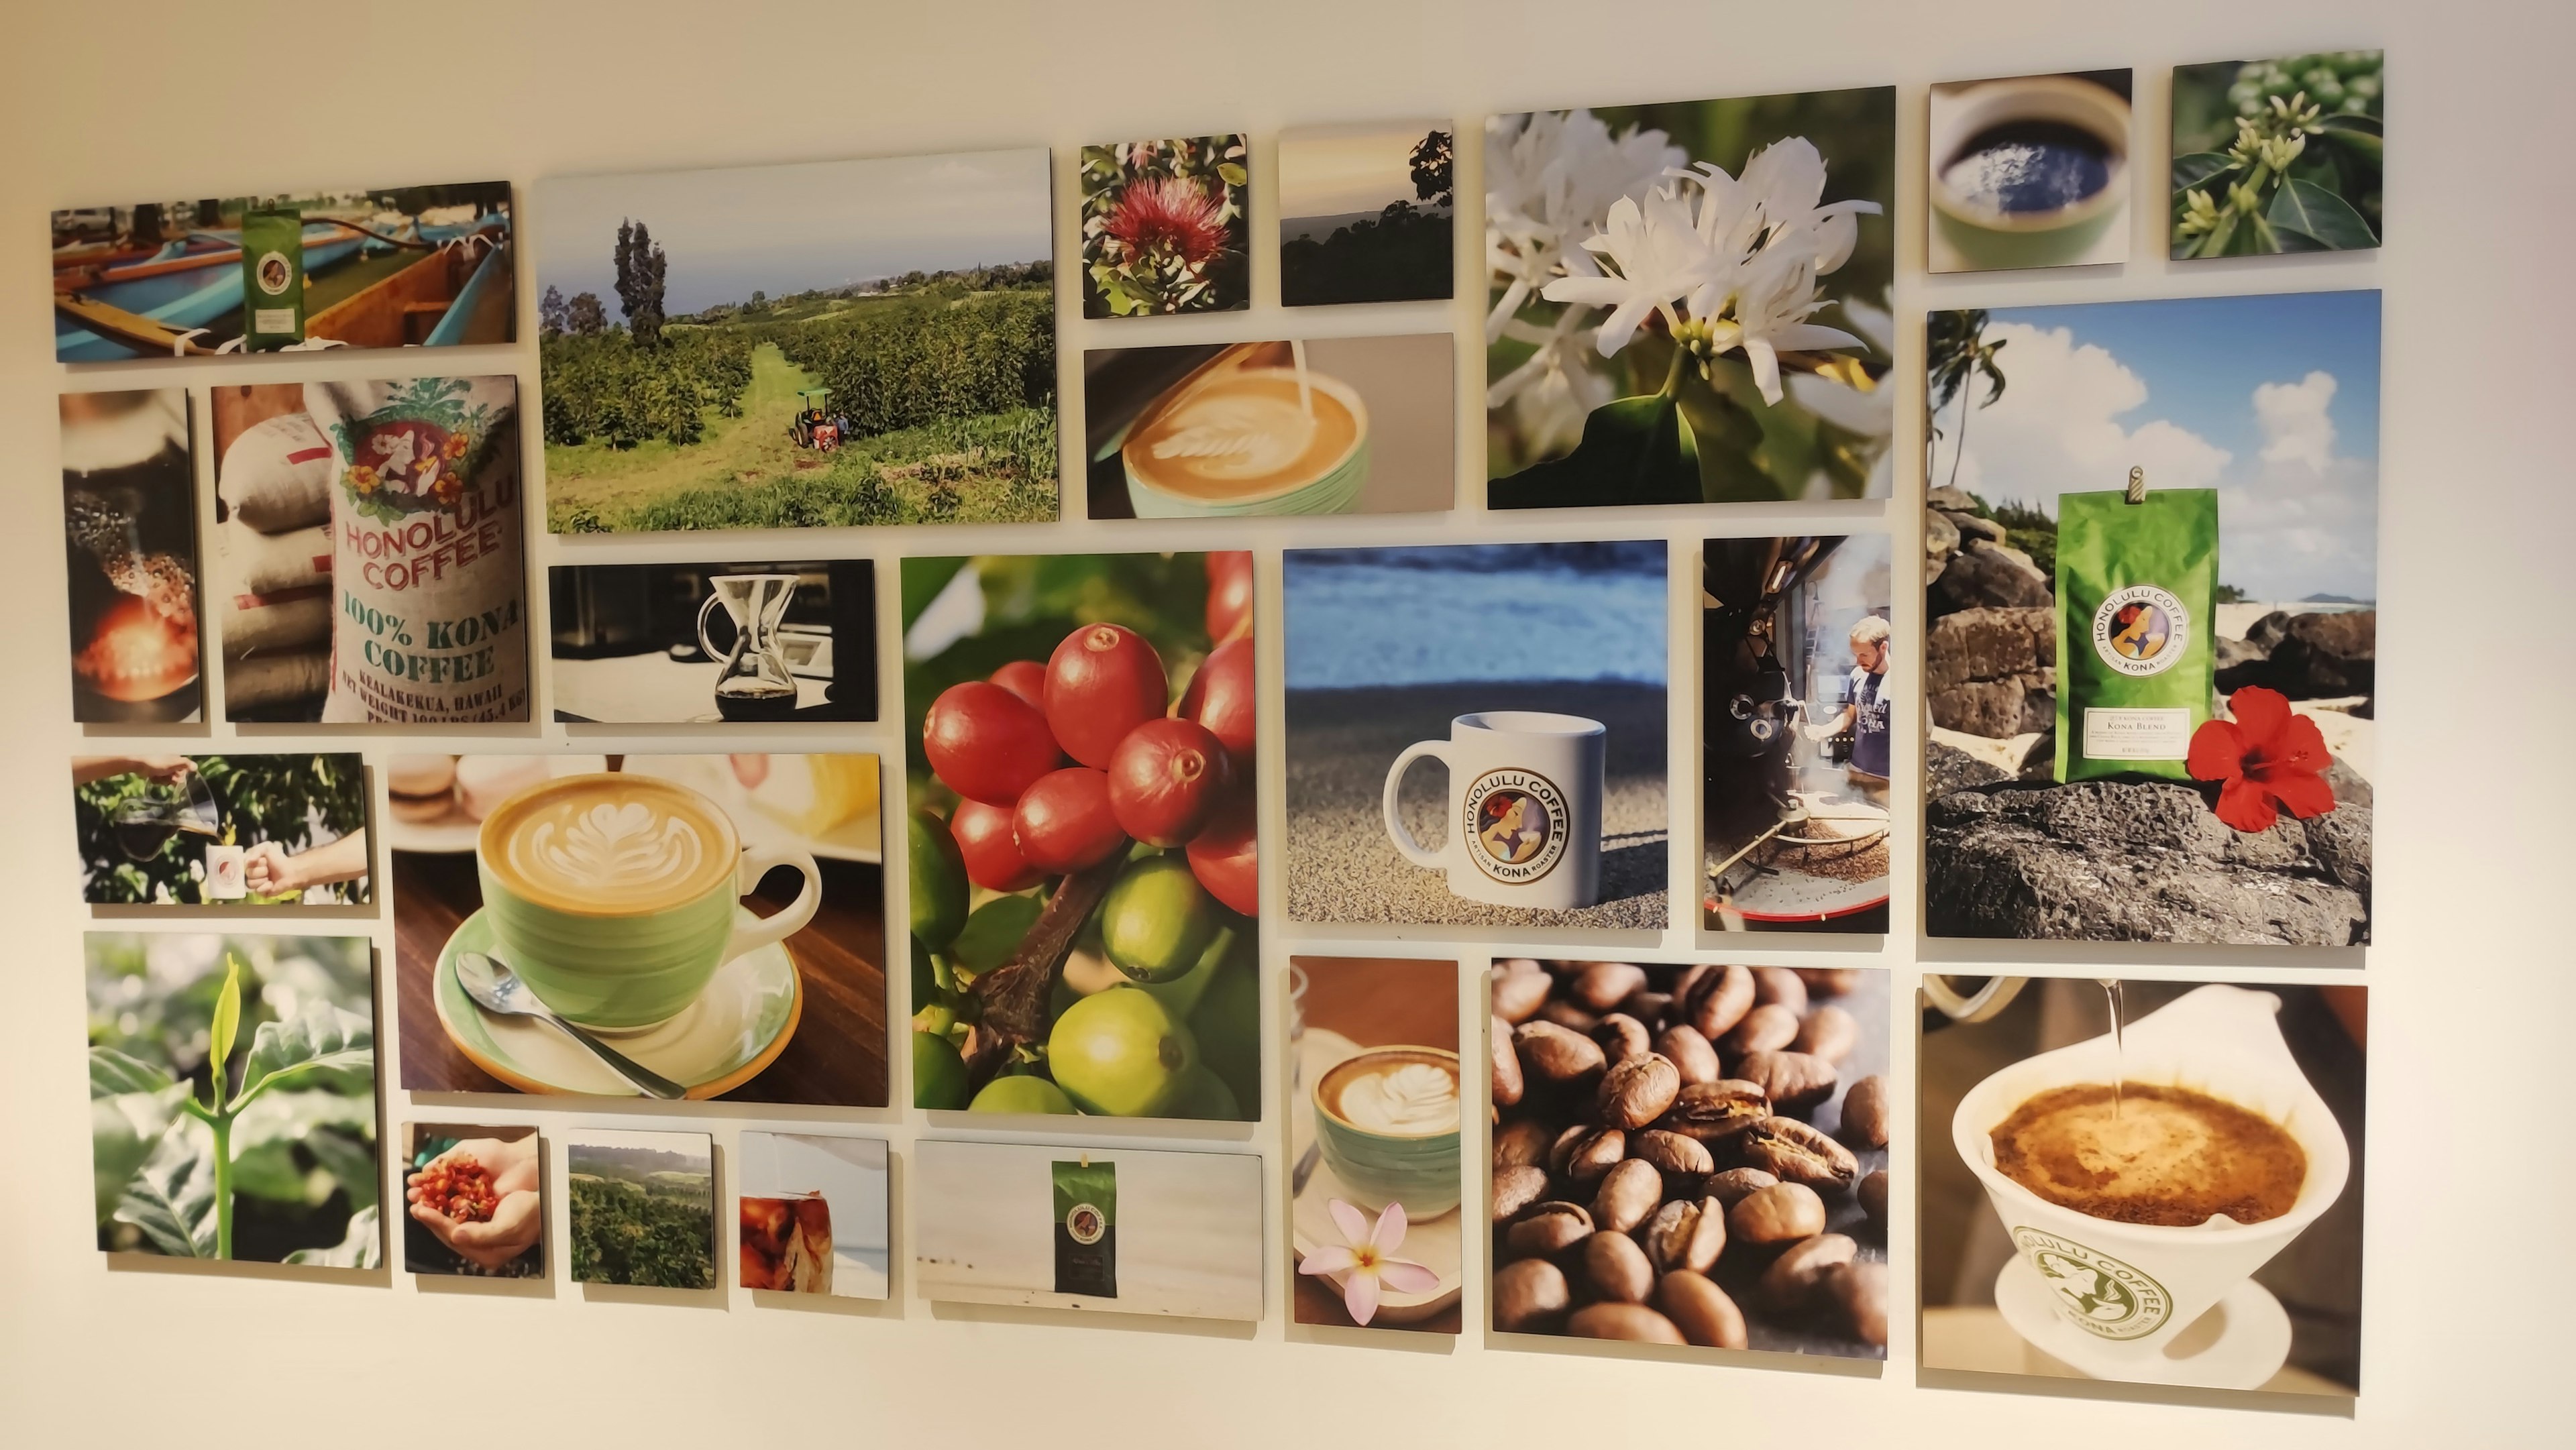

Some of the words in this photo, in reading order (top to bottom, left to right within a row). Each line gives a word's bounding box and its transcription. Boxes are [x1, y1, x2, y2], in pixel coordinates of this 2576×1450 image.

[345, 473, 515, 559] HONOLULU
[362, 520, 502, 592] COFFEE
[344, 589, 413, 646] 100%
[427, 599, 518, 650] KONA
[2096, 589, 2151, 642] HONOLULU
[2154, 593, 2184, 642] COFFEE
[364, 640, 495, 683] COFFEE
[2123, 662, 2156, 671] KONA
[342, 669, 357, 694] NET
[360, 687, 409, 722] WEIGHT
[454, 683, 502, 712] HAWAII
[1466, 775, 1525, 834] HONOLULU
[1529, 781, 1564, 842] COFFEE
[1472, 840, 1492, 867] ARTISAN
[1493, 864, 1531, 878] KONA
[1531, 845, 1557, 872] ROASTER
[2097, 1260, 2161, 1316] COFFEE
